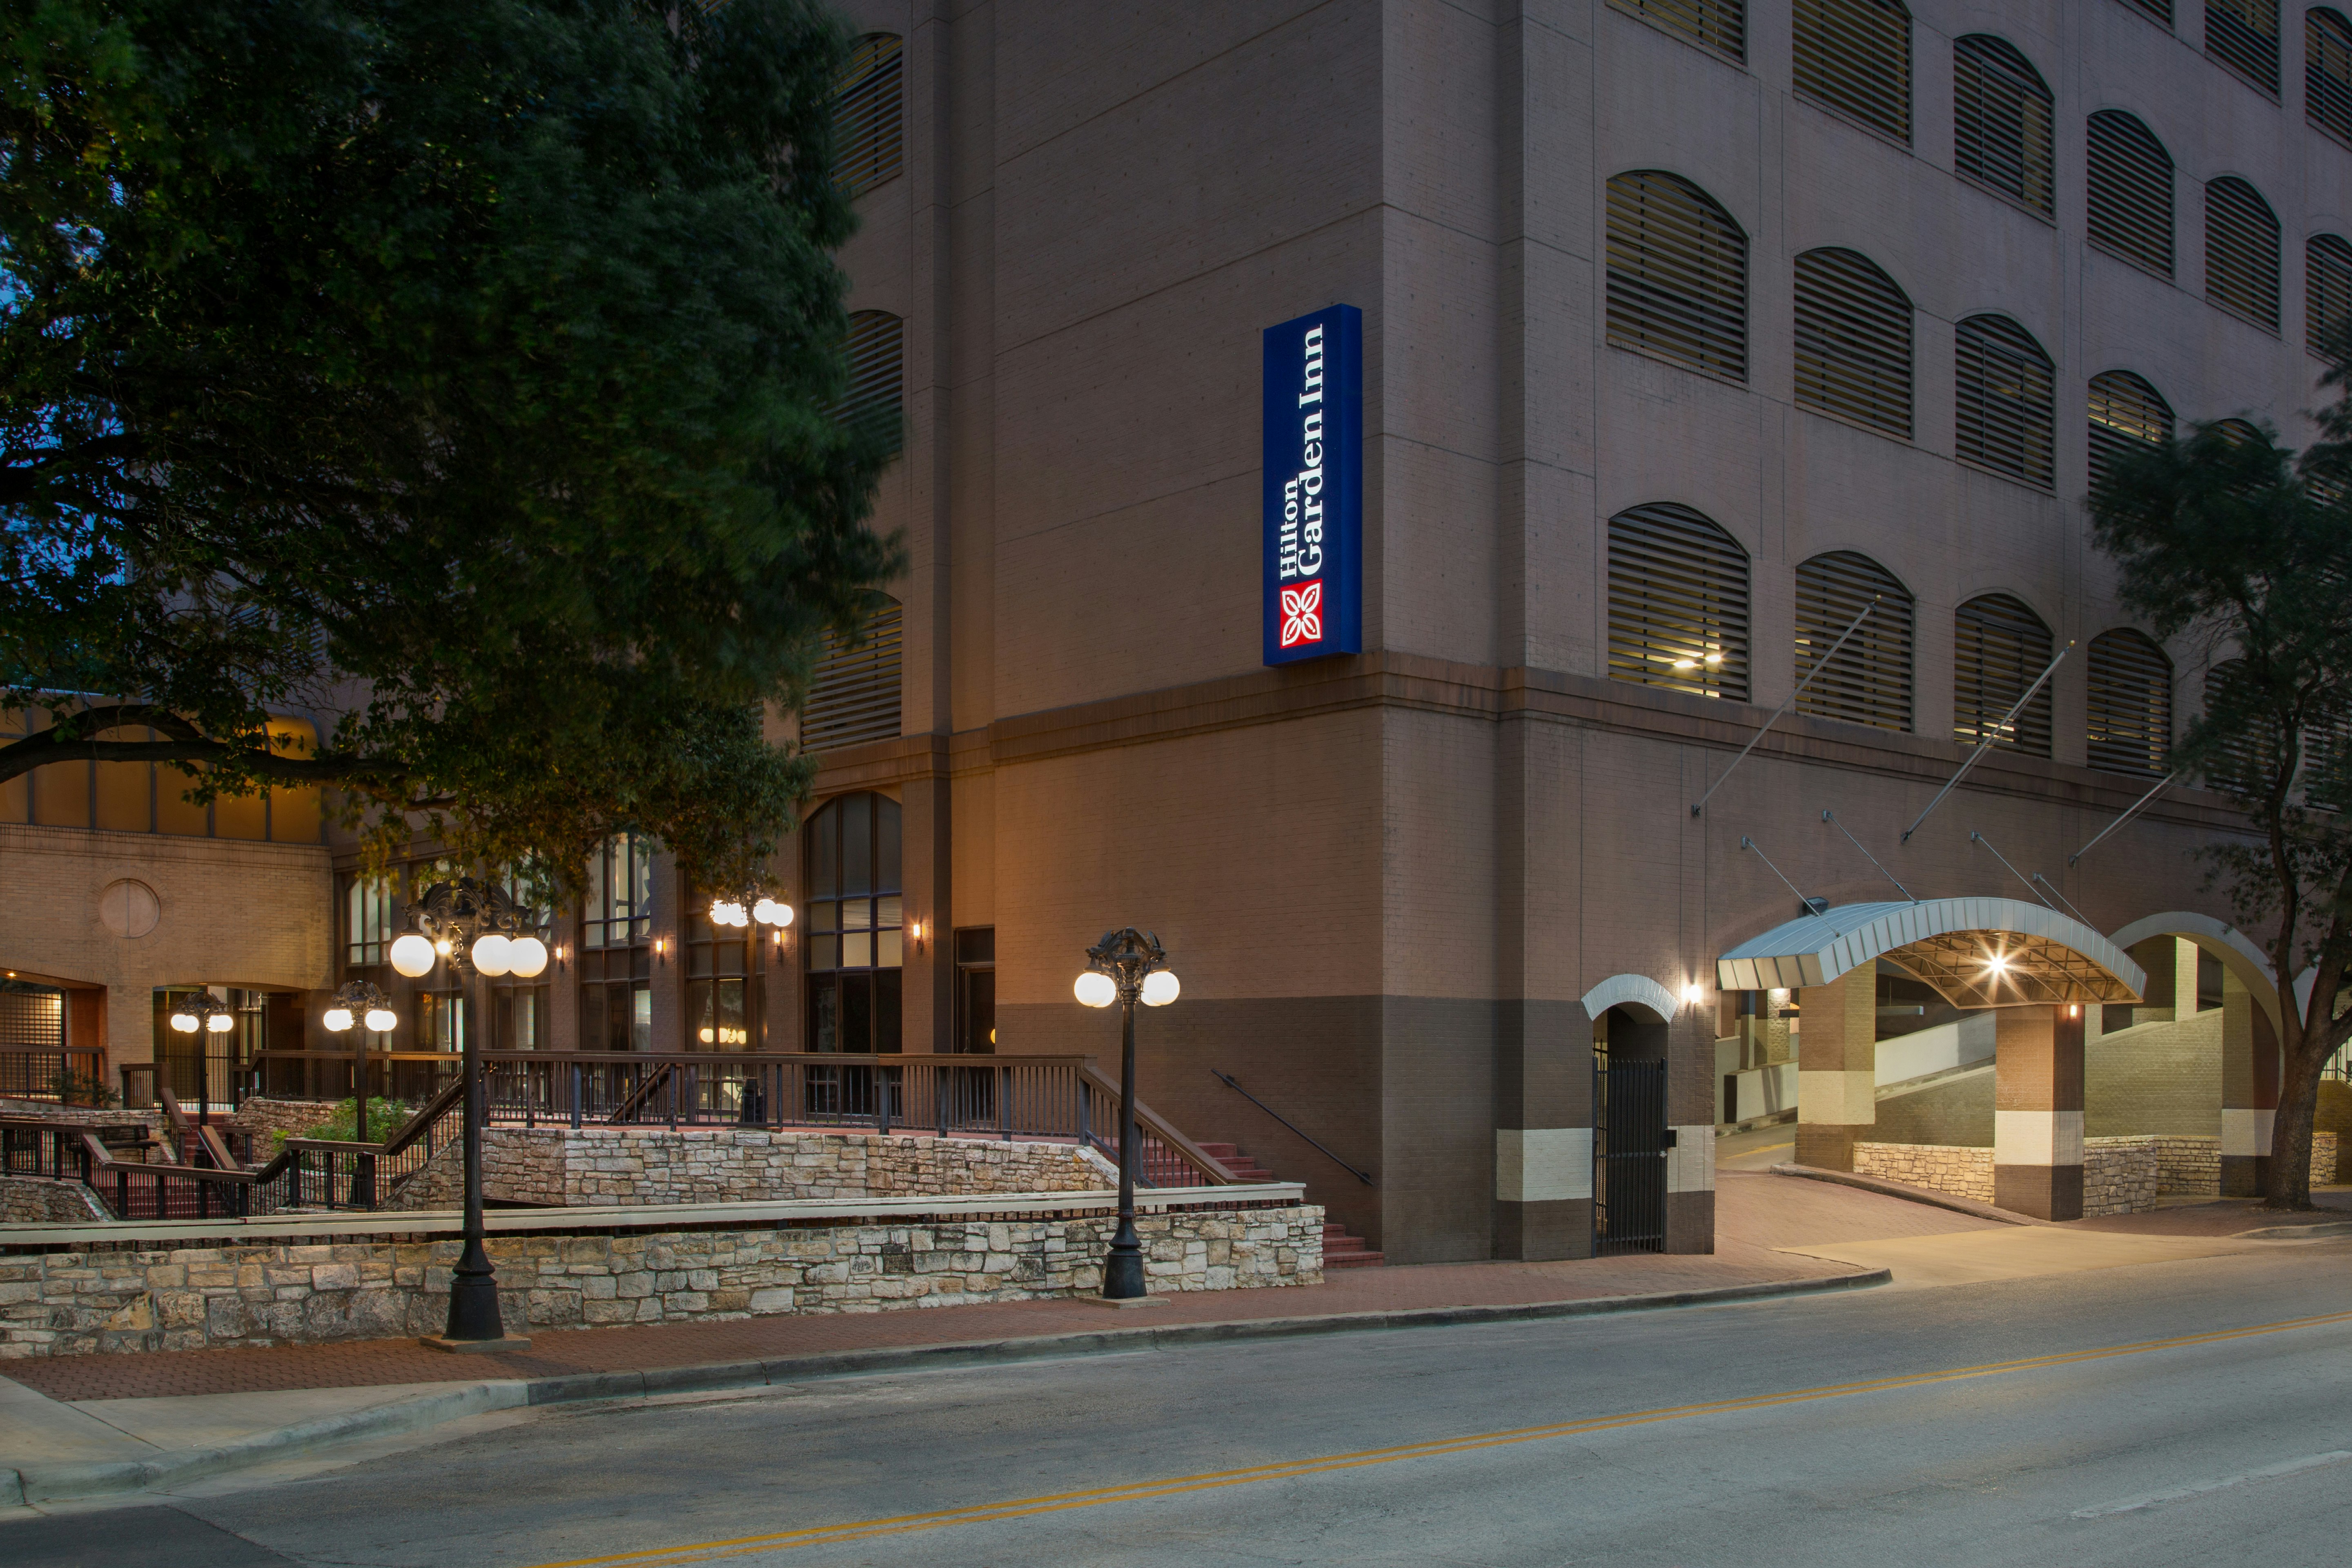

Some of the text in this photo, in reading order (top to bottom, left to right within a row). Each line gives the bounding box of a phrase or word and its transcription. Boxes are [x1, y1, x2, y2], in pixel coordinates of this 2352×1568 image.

[1280, 477, 1298, 580] Hilton
[1298, 323, 1323, 575] Garden Inn
